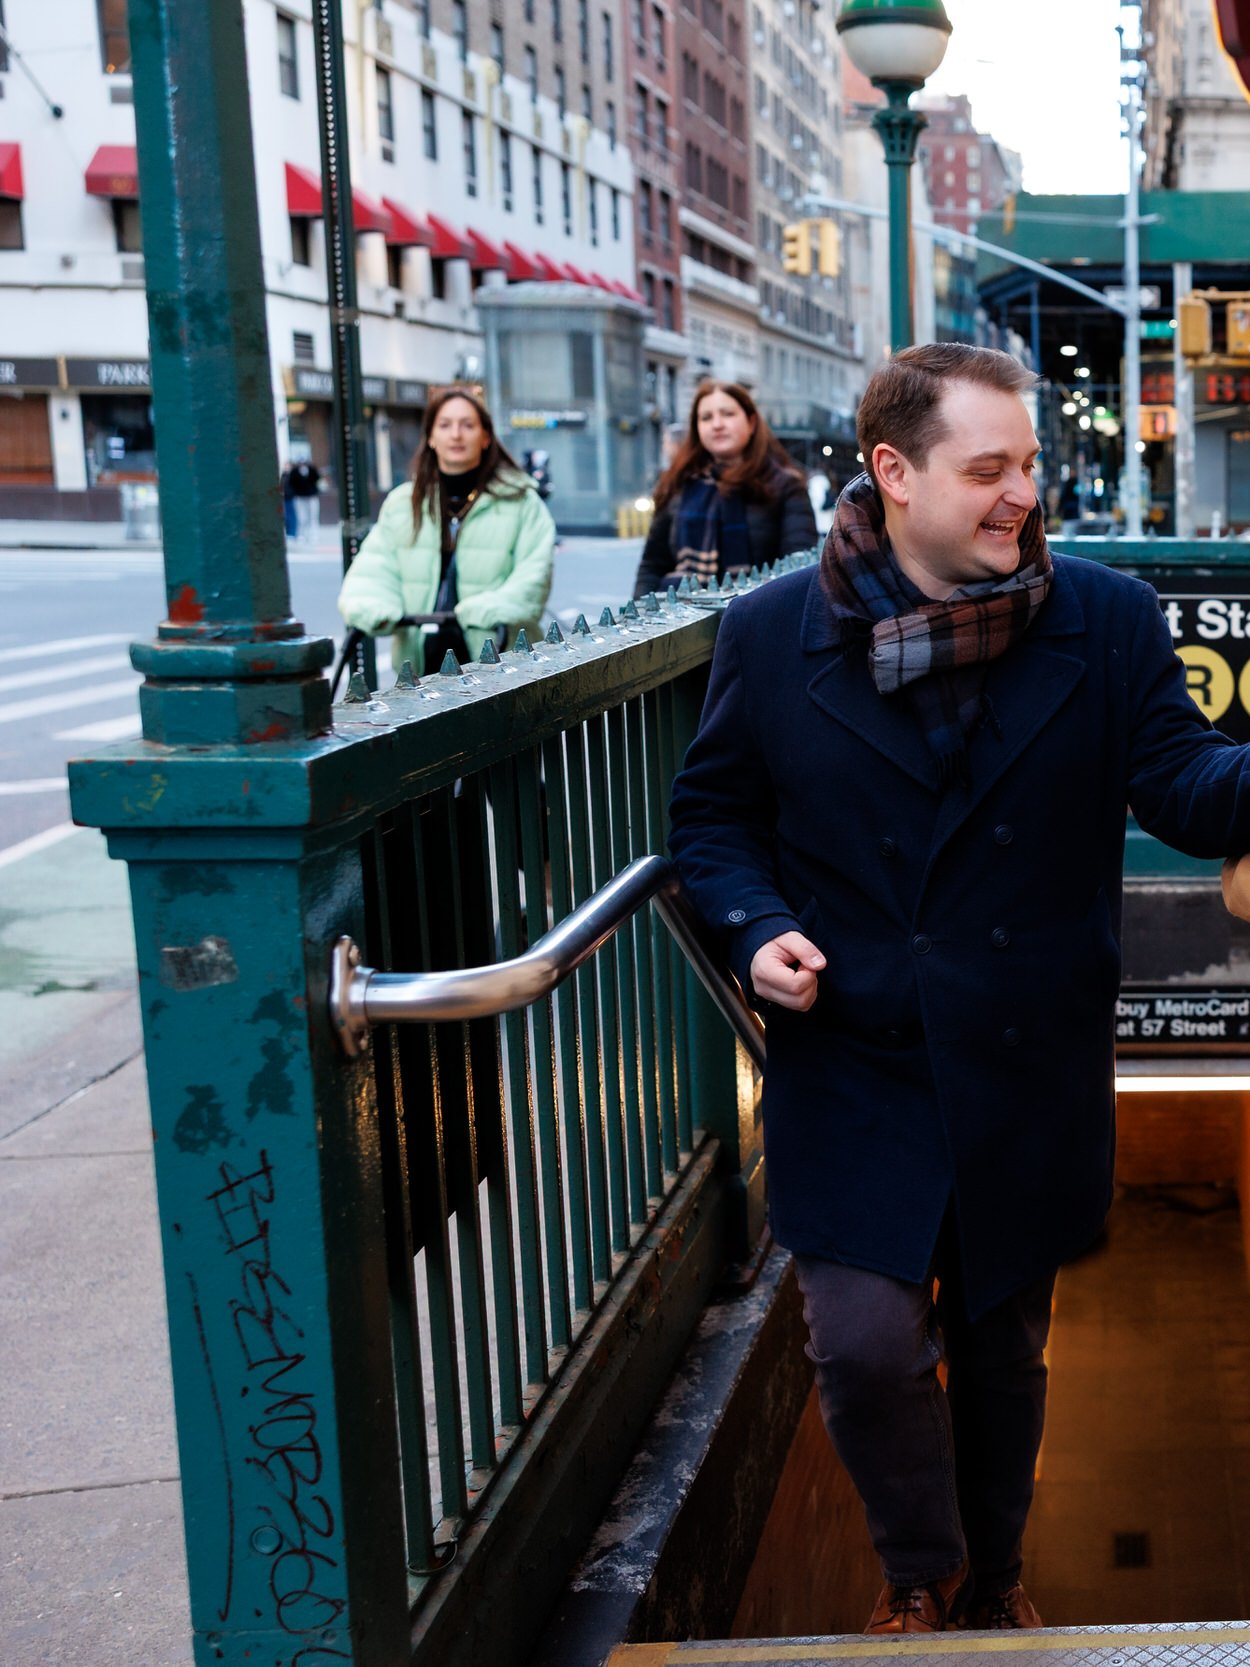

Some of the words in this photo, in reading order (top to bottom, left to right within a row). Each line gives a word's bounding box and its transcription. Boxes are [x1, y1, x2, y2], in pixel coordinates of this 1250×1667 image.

[1115, 1000, 1149, 1018] buy
[1155, 1000, 1249, 1016] MetroCard
[1116, 1020, 1135, 1036] at
[1141, 1019, 1164, 1036] 57
[1170, 1019, 1226, 1036] Street
